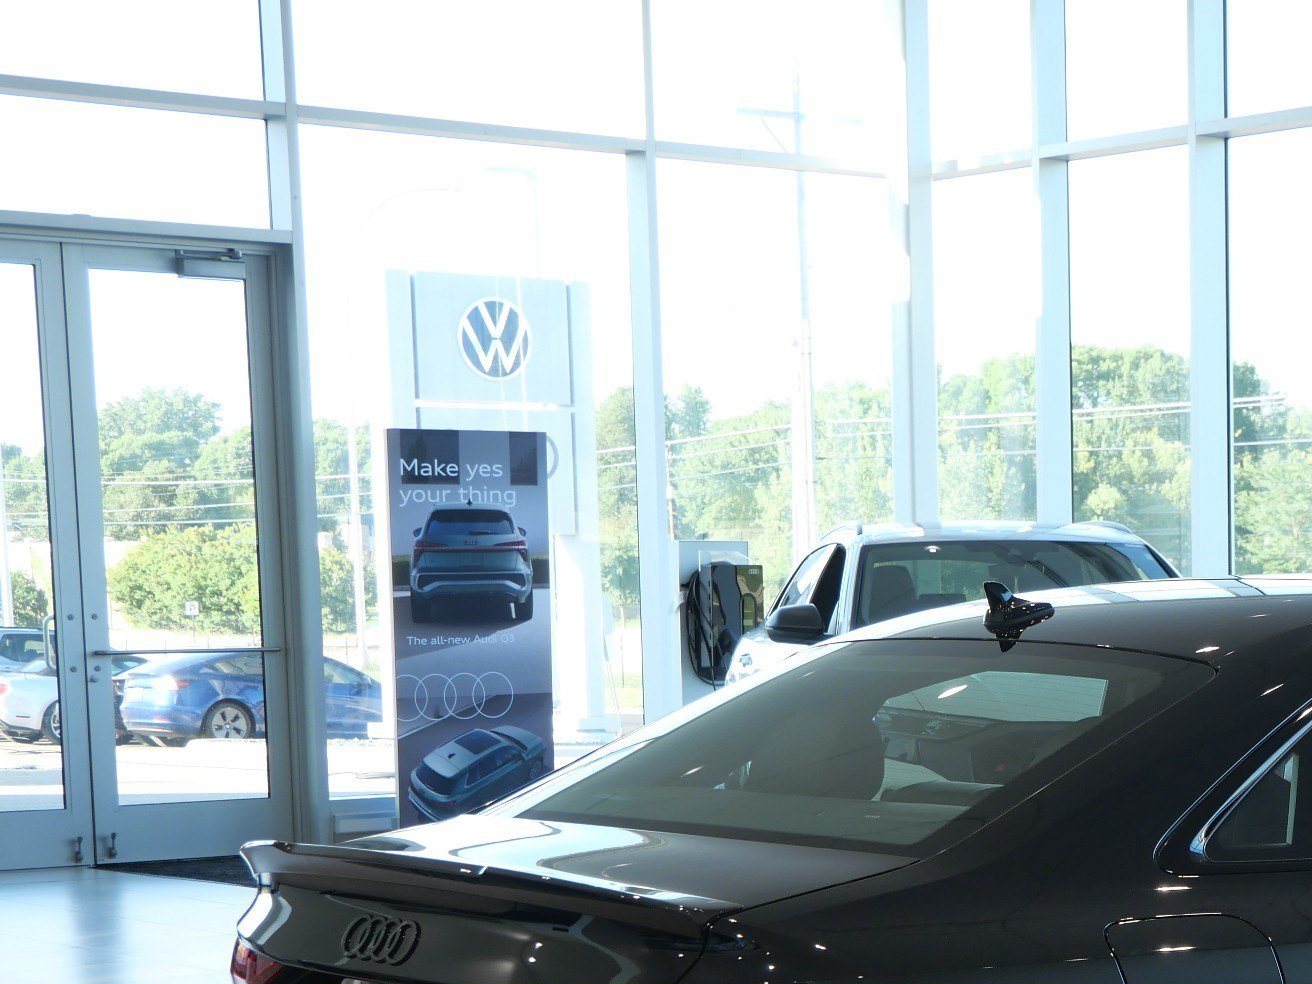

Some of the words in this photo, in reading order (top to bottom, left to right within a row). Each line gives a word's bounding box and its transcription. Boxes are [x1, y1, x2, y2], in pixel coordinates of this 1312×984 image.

[400, 458, 459, 477] Make
[466, 462, 503, 481] yes
[399, 488, 451, 507] your
[458, 485, 516, 507] thing
[406, 636, 428, 646] The
[430, 636, 471, 645] all-new
[473, 634, 497, 645] Audi
[500, 634, 515, 645] Q3
